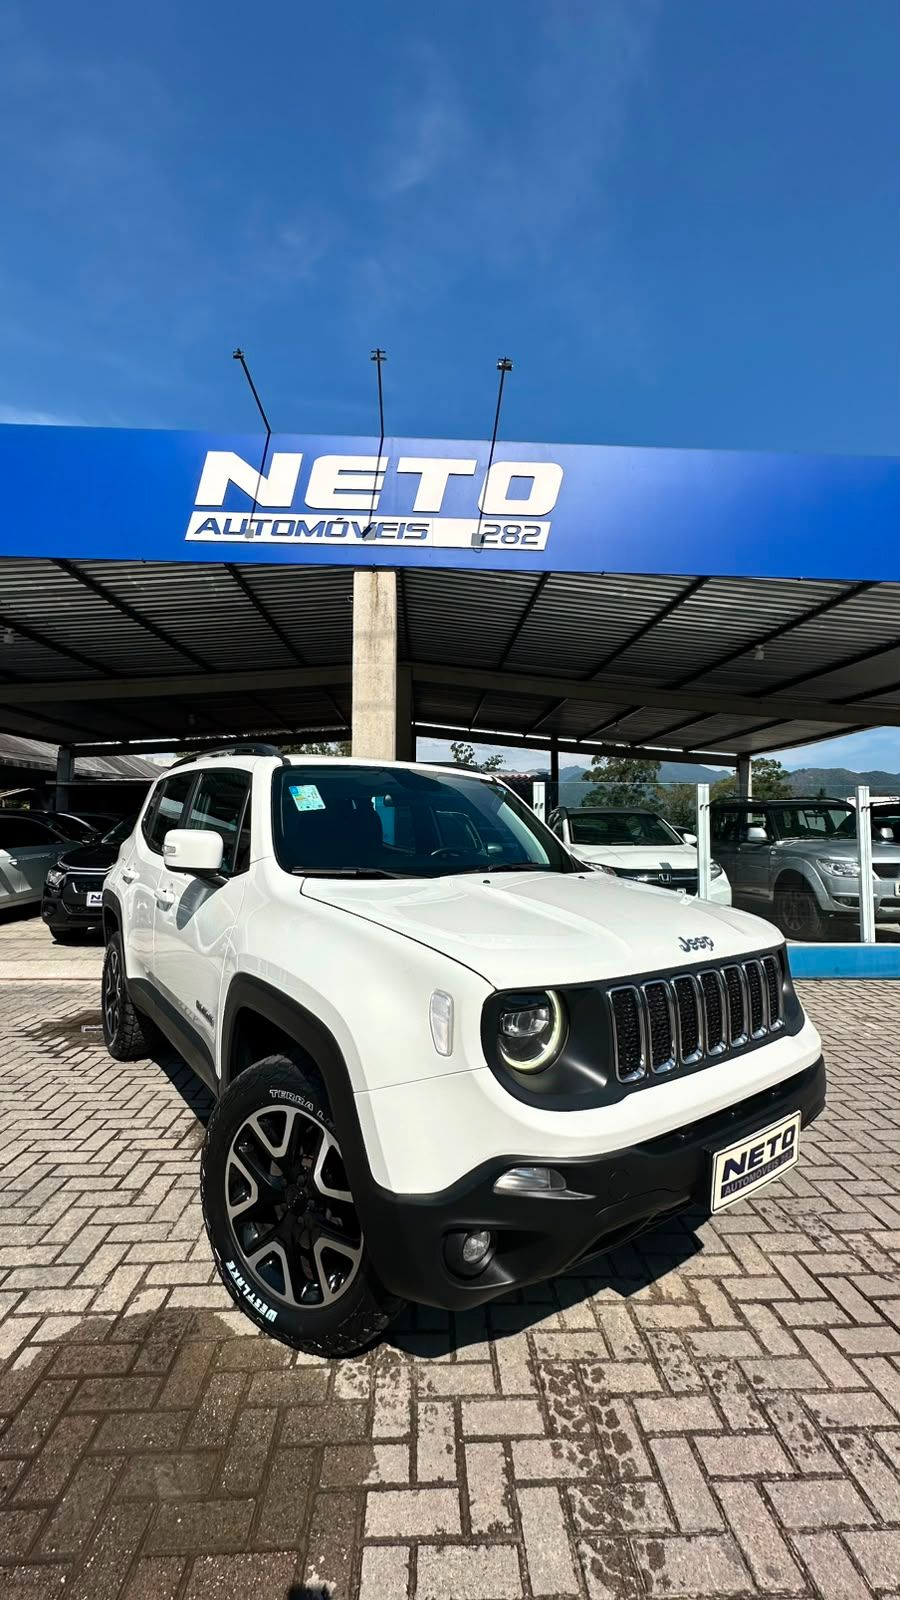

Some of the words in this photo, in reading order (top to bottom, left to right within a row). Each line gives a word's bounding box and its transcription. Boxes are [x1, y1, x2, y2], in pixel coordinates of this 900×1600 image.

[194, 450, 564, 516] NETO
[194, 517, 430, 540] AUTOMÓVEIS
[480, 524, 542, 545] 282
[678, 936, 714, 952] Jeep
[269, 1089, 314, 1111] TERRA
[722, 1124, 796, 1183] NETO
[226, 1260, 278, 1322] WESTLAKE
